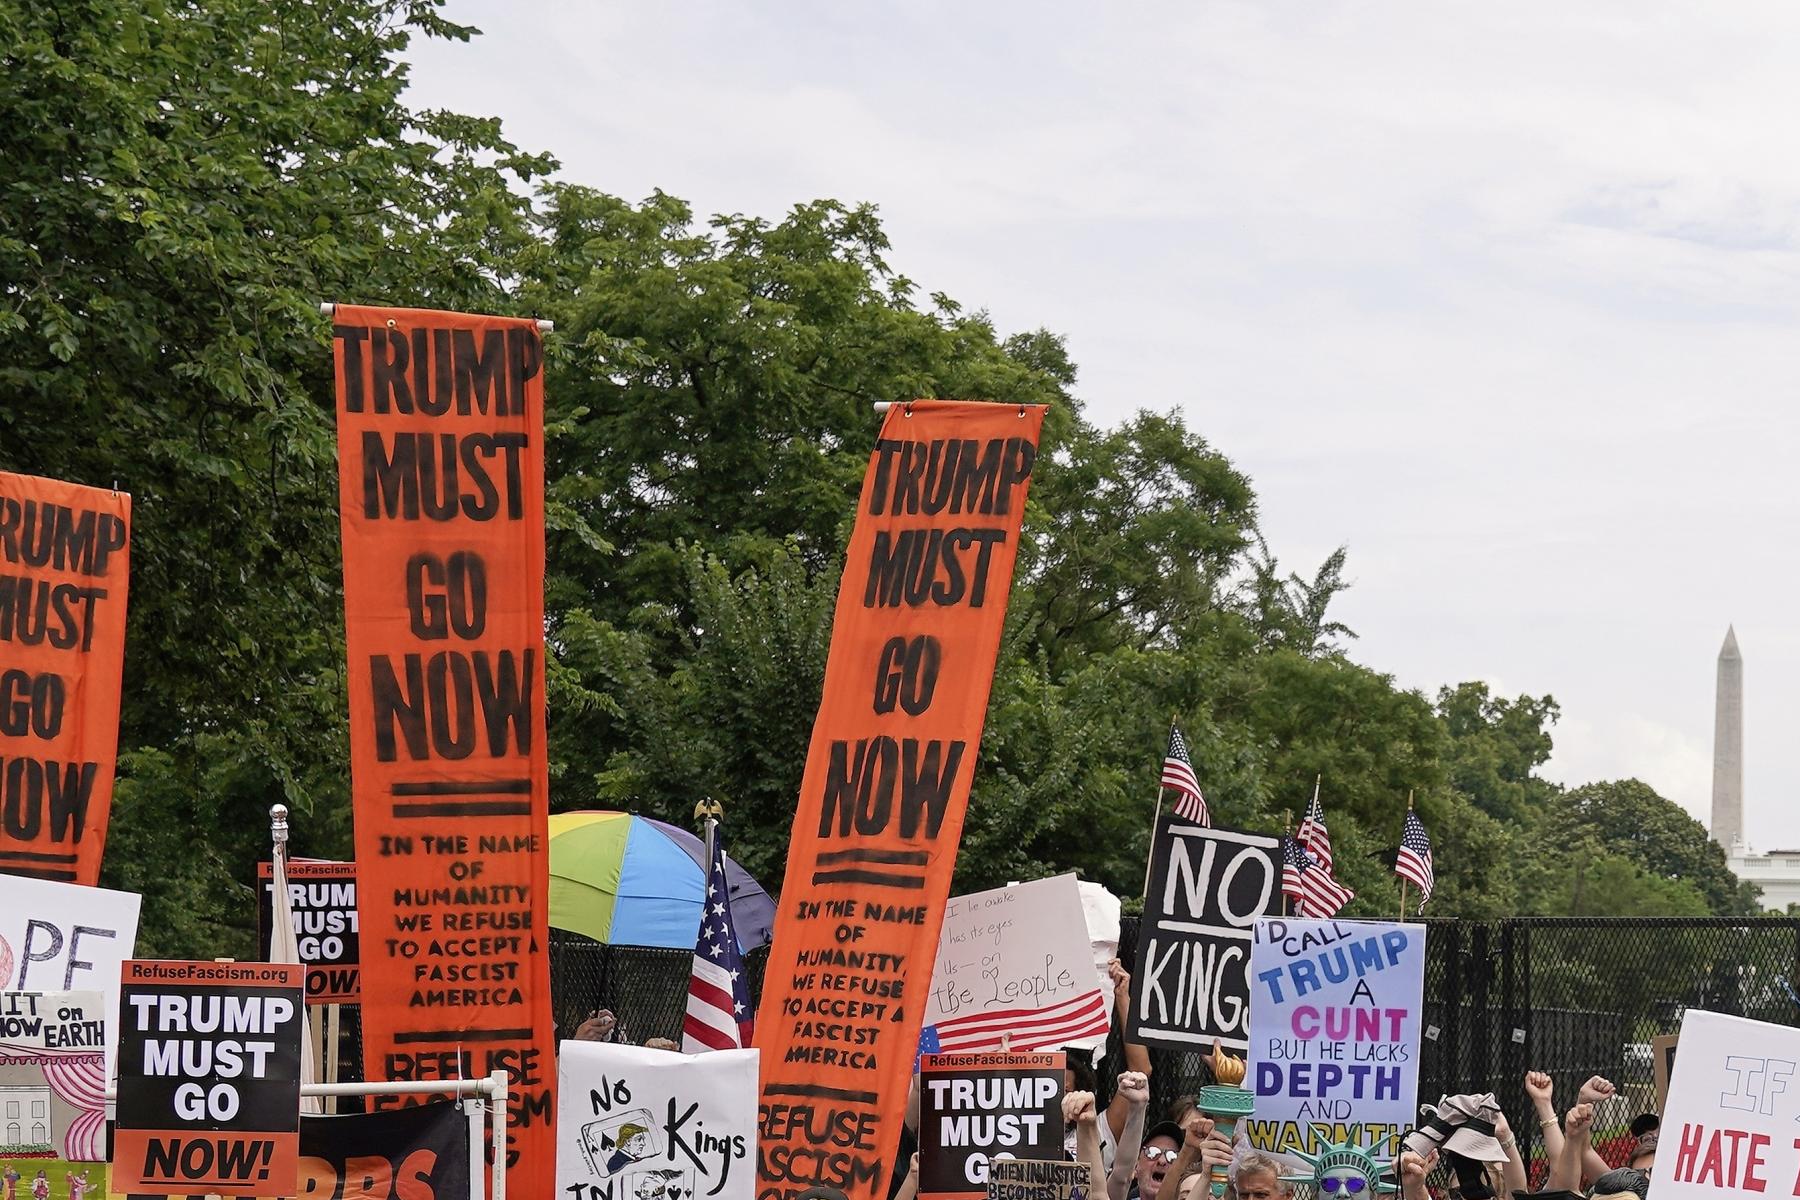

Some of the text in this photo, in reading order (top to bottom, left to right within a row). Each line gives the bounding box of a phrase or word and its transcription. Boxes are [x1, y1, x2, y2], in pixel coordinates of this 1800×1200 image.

[334, 325, 543, 418] TRUMP
[362, 431, 528, 522] MUST
[868, 437, 1036, 516] TRUMP
[863, 528, 1006, 608] MUST
[406, 549, 488, 641] GO
[873, 635, 942, 716] GO
[0, 669, 65, 740] GO
[369, 648, 536, 763] NOW
[817, 735, 967, 839] NOW
[1163, 835, 1274, 928] NO
[1283, 922, 1352, 957] CALL
[132, 962, 288, 985] RefuseFascism.org
[1139, 938, 1251, 1034] KING
[1258, 930, 1409, 1005] TRUMP
[129, 994, 295, 1035] TRUMP
[1349, 979, 1376, 1006] A
[1291, 1005, 1408, 1042] CUNT
[142, 1039, 275, 1079] MUST
[929, 1053, 1053, 1067] RefuseFascism.org
[1269, 1038, 1409, 1063] BUT HE LACKS
[173, 1083, 240, 1123] GO
[590, 1075, 632, 1115] NO
[928, 1077, 1058, 1110] TRUMP
[1256, 1062, 1401, 1101] DEPTH
[1720, 1056, 1796, 1116] IF
[940, 1115, 1044, 1147] MUST
[1297, 1100, 1352, 1120] AND
[142, 1137, 275, 1181] NOW!
[663, 1097, 746, 1196] Kings
[1674, 1123, 1771, 1194] HATE
[988, 1183, 1056, 1200] BECOMES
